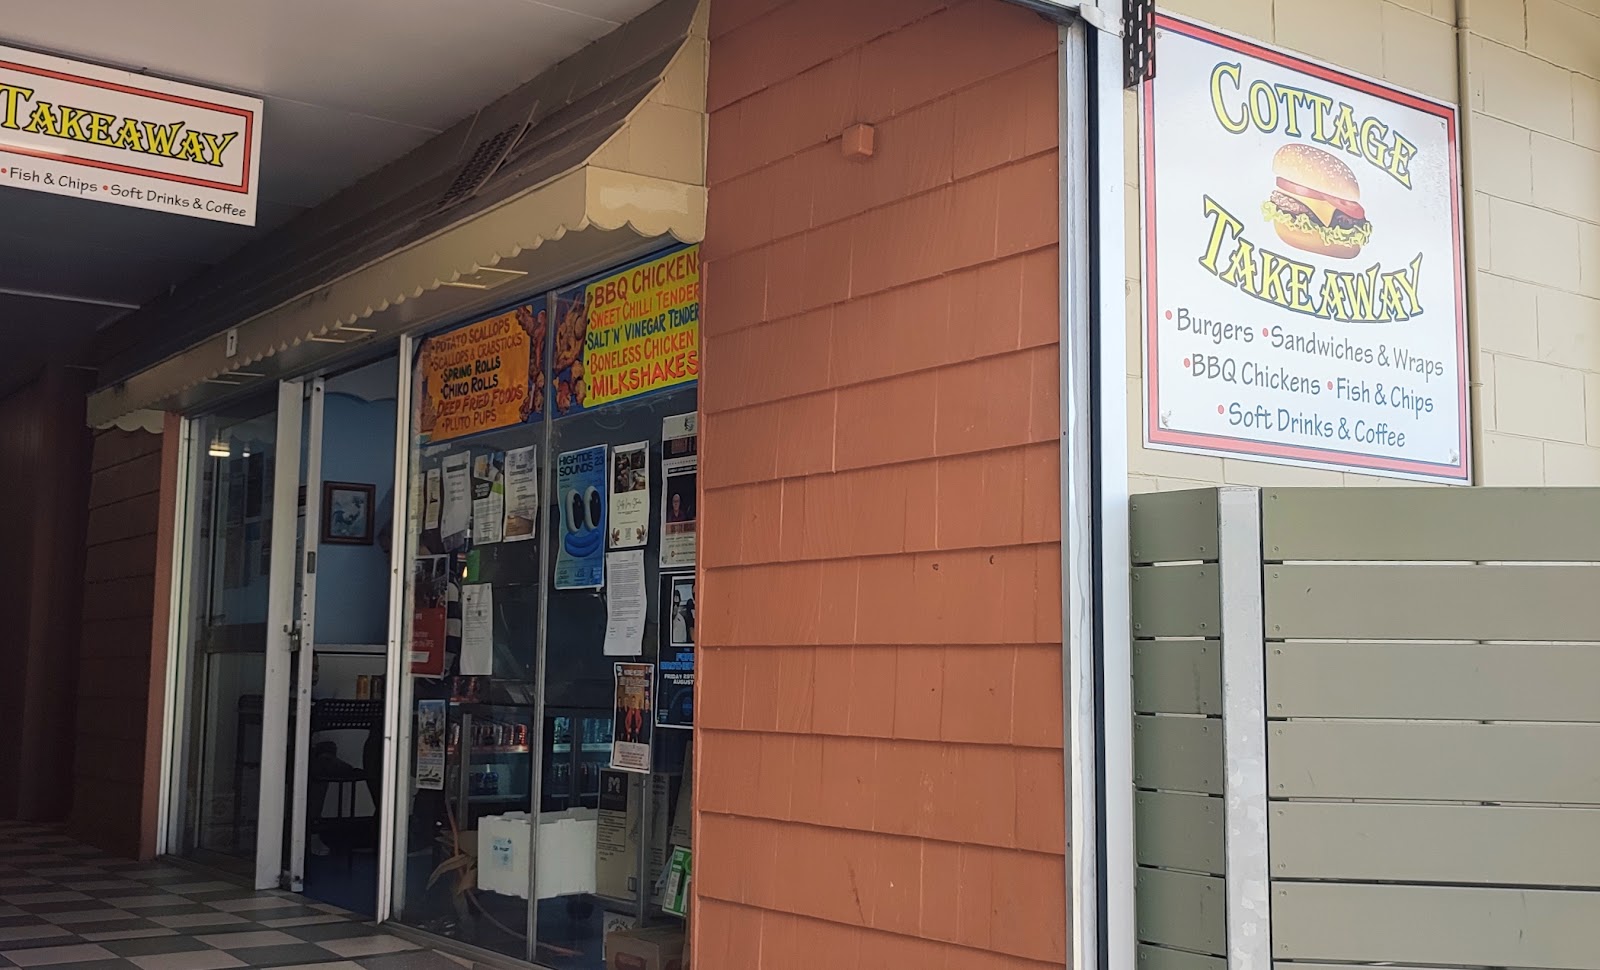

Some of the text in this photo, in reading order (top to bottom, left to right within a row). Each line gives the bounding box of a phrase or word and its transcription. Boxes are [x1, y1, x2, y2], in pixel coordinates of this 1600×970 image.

[0, 82, 238, 167] TAKEAWAY
[1210, 61, 1417, 190] COTTAGE
[10, 167, 247, 217] Fish & Chips Soft Drinks & Coffee
[1198, 194, 1424, 323] TAKEAWAY
[595, 276, 628, 308] BBQ
[588, 329, 610, 350] SALT
[625, 313, 666, 341] VINEGAR
[590, 307, 621, 330] SWEET
[623, 297, 652, 321] CHILLI
[433, 350, 469, 371] SCALLOPS
[477, 333, 522, 359] CRABSTICKS
[435, 317, 510, 353] POTATO SCALLOPS
[590, 329, 694, 375] BONELESS CHICKEN
[1176, 307, 1444, 383] Burgers Sandwiches & Wraps
[442, 374, 498, 399] CHIKO ROLLS
[443, 355, 501, 382] SPRING ROLLS
[592, 350, 699, 400] MILKSHAKES
[1192, 353, 1434, 420] BBQ Chickens Fish & Chips
[437, 384, 523, 419] DEEP FRIED FOODS
[445, 416, 470, 432] PLUTO
[1228, 402, 1406, 447] Soft Drinks & Coffee
[559, 462, 593, 476] SOUNDS
